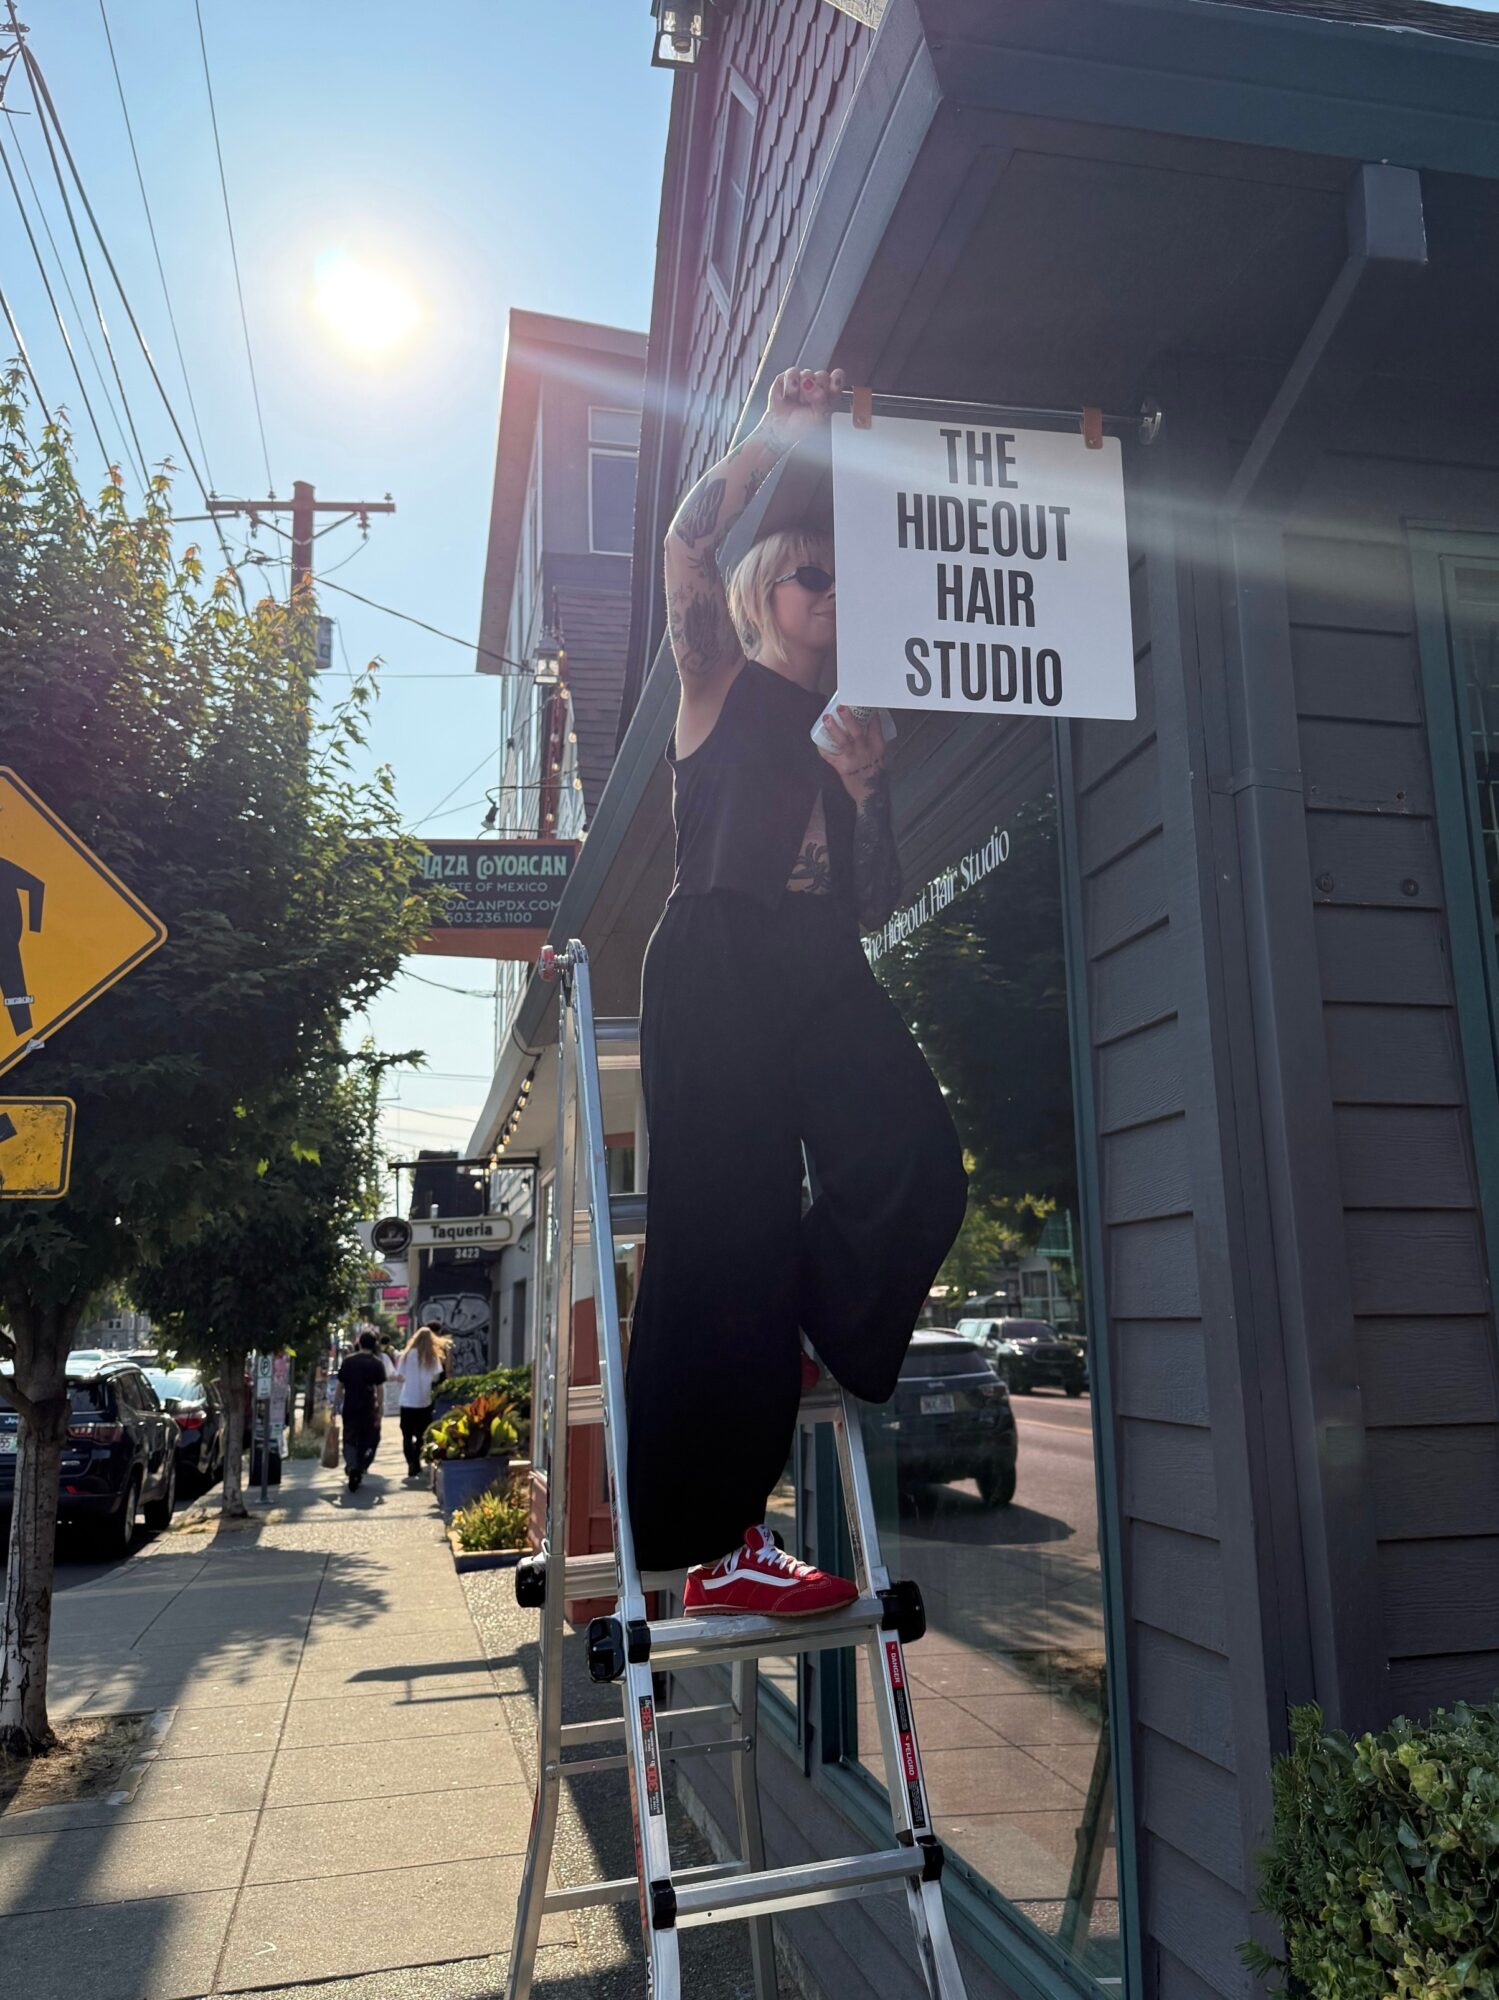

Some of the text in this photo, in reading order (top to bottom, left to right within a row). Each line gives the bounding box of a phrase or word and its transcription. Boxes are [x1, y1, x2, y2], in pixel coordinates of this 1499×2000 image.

[939, 428, 1018, 489] THE
[897, 491, 1070, 561] HIDEOUT
[936, 563, 1035, 628] HAIR
[904, 637, 1063, 707] STUDIO
[475, 882, 493, 893] OF
[497, 882, 548, 893] MEXICO
[884, 887, 929, 953] Hideout
[930, 866, 957, 916] Hair
[960, 826, 1010, 892] Studio
[431, 1223, 493, 1241] Taqueria
[454, 1247, 480, 1259] 3423
[890, 1652, 900, 1683] DANGER
[904, 1742, 915, 1776] PELIGRO
